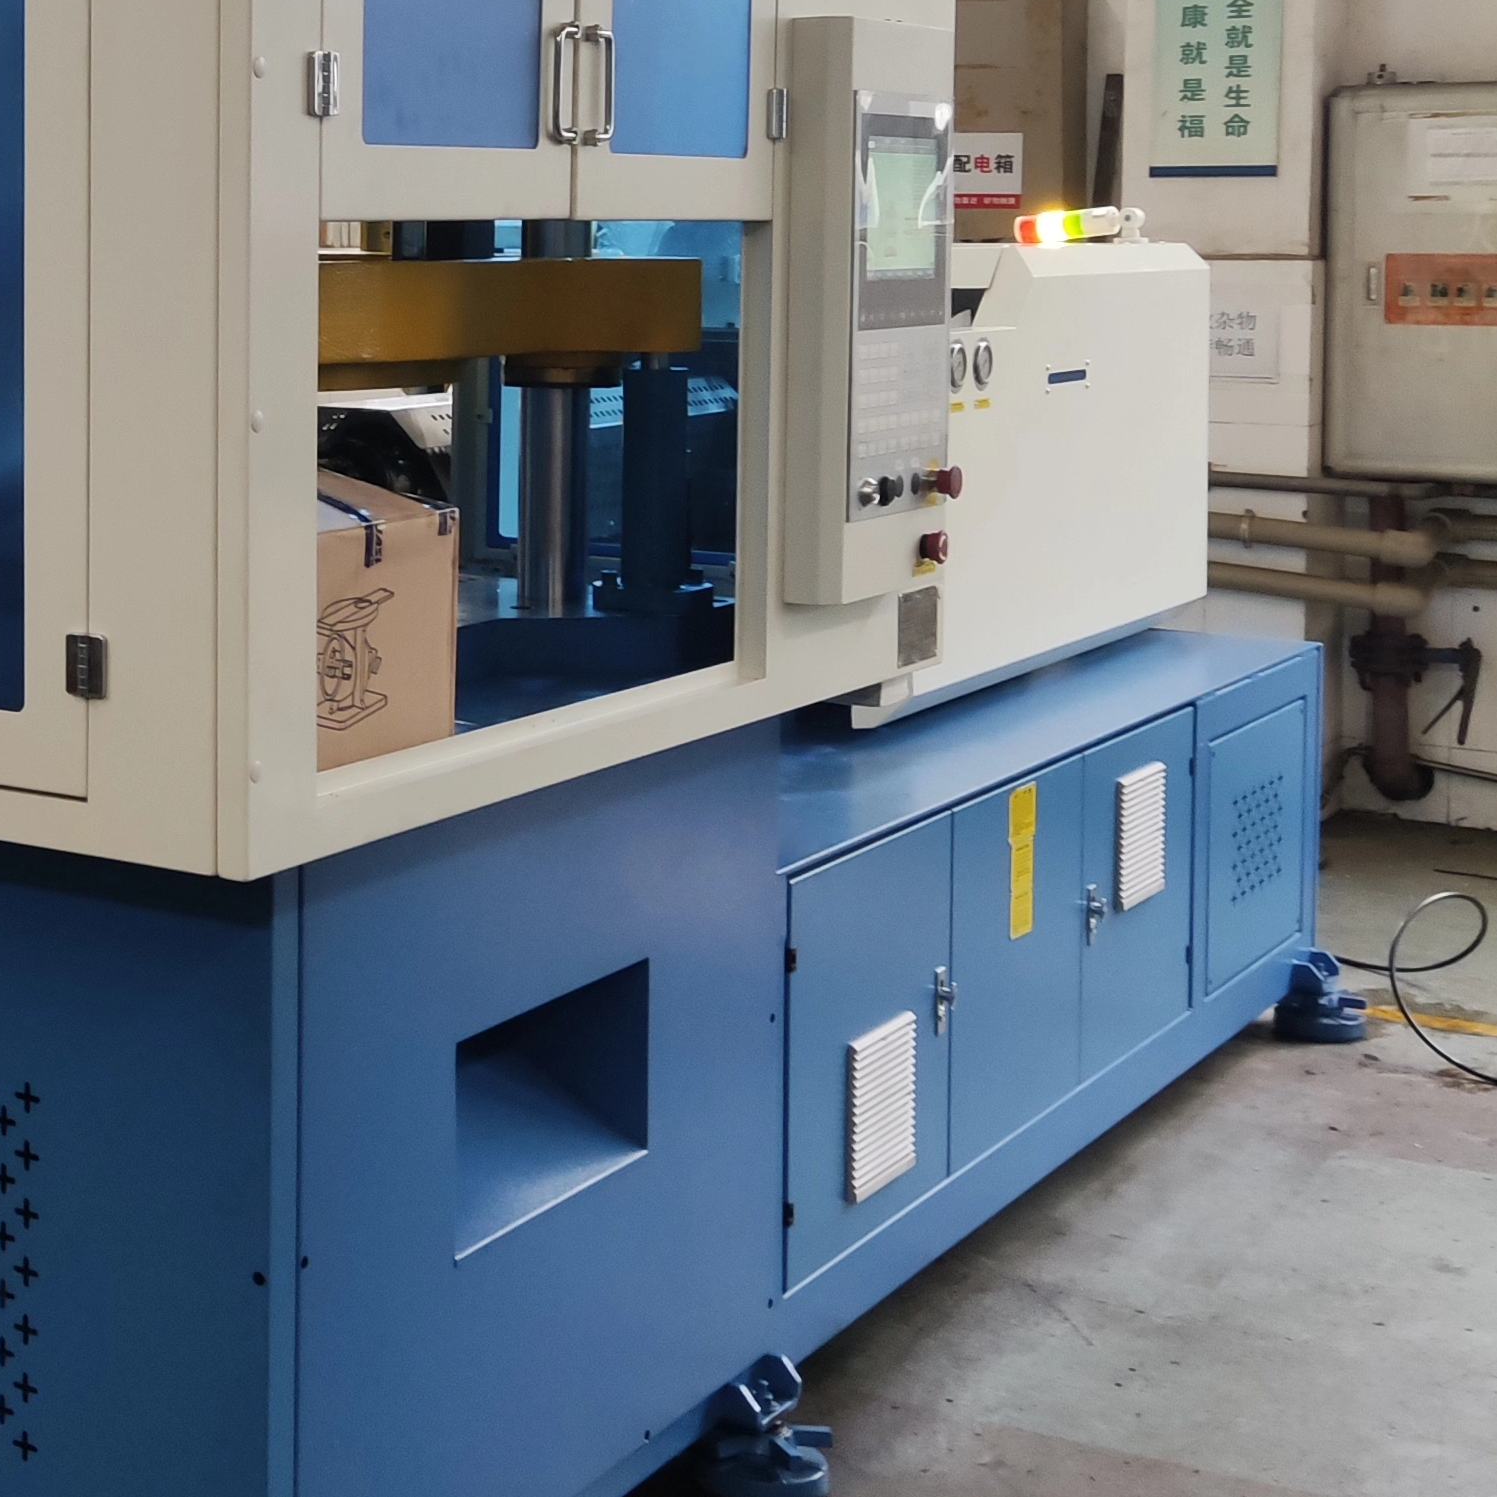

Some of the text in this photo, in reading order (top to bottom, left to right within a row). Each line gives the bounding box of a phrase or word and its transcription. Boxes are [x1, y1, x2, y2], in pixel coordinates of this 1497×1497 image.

[953, 154, 1015, 174] 配电箱
[1210, 311, 1257, 331] 杂物
[1210, 337, 1255, 357] 畅通
